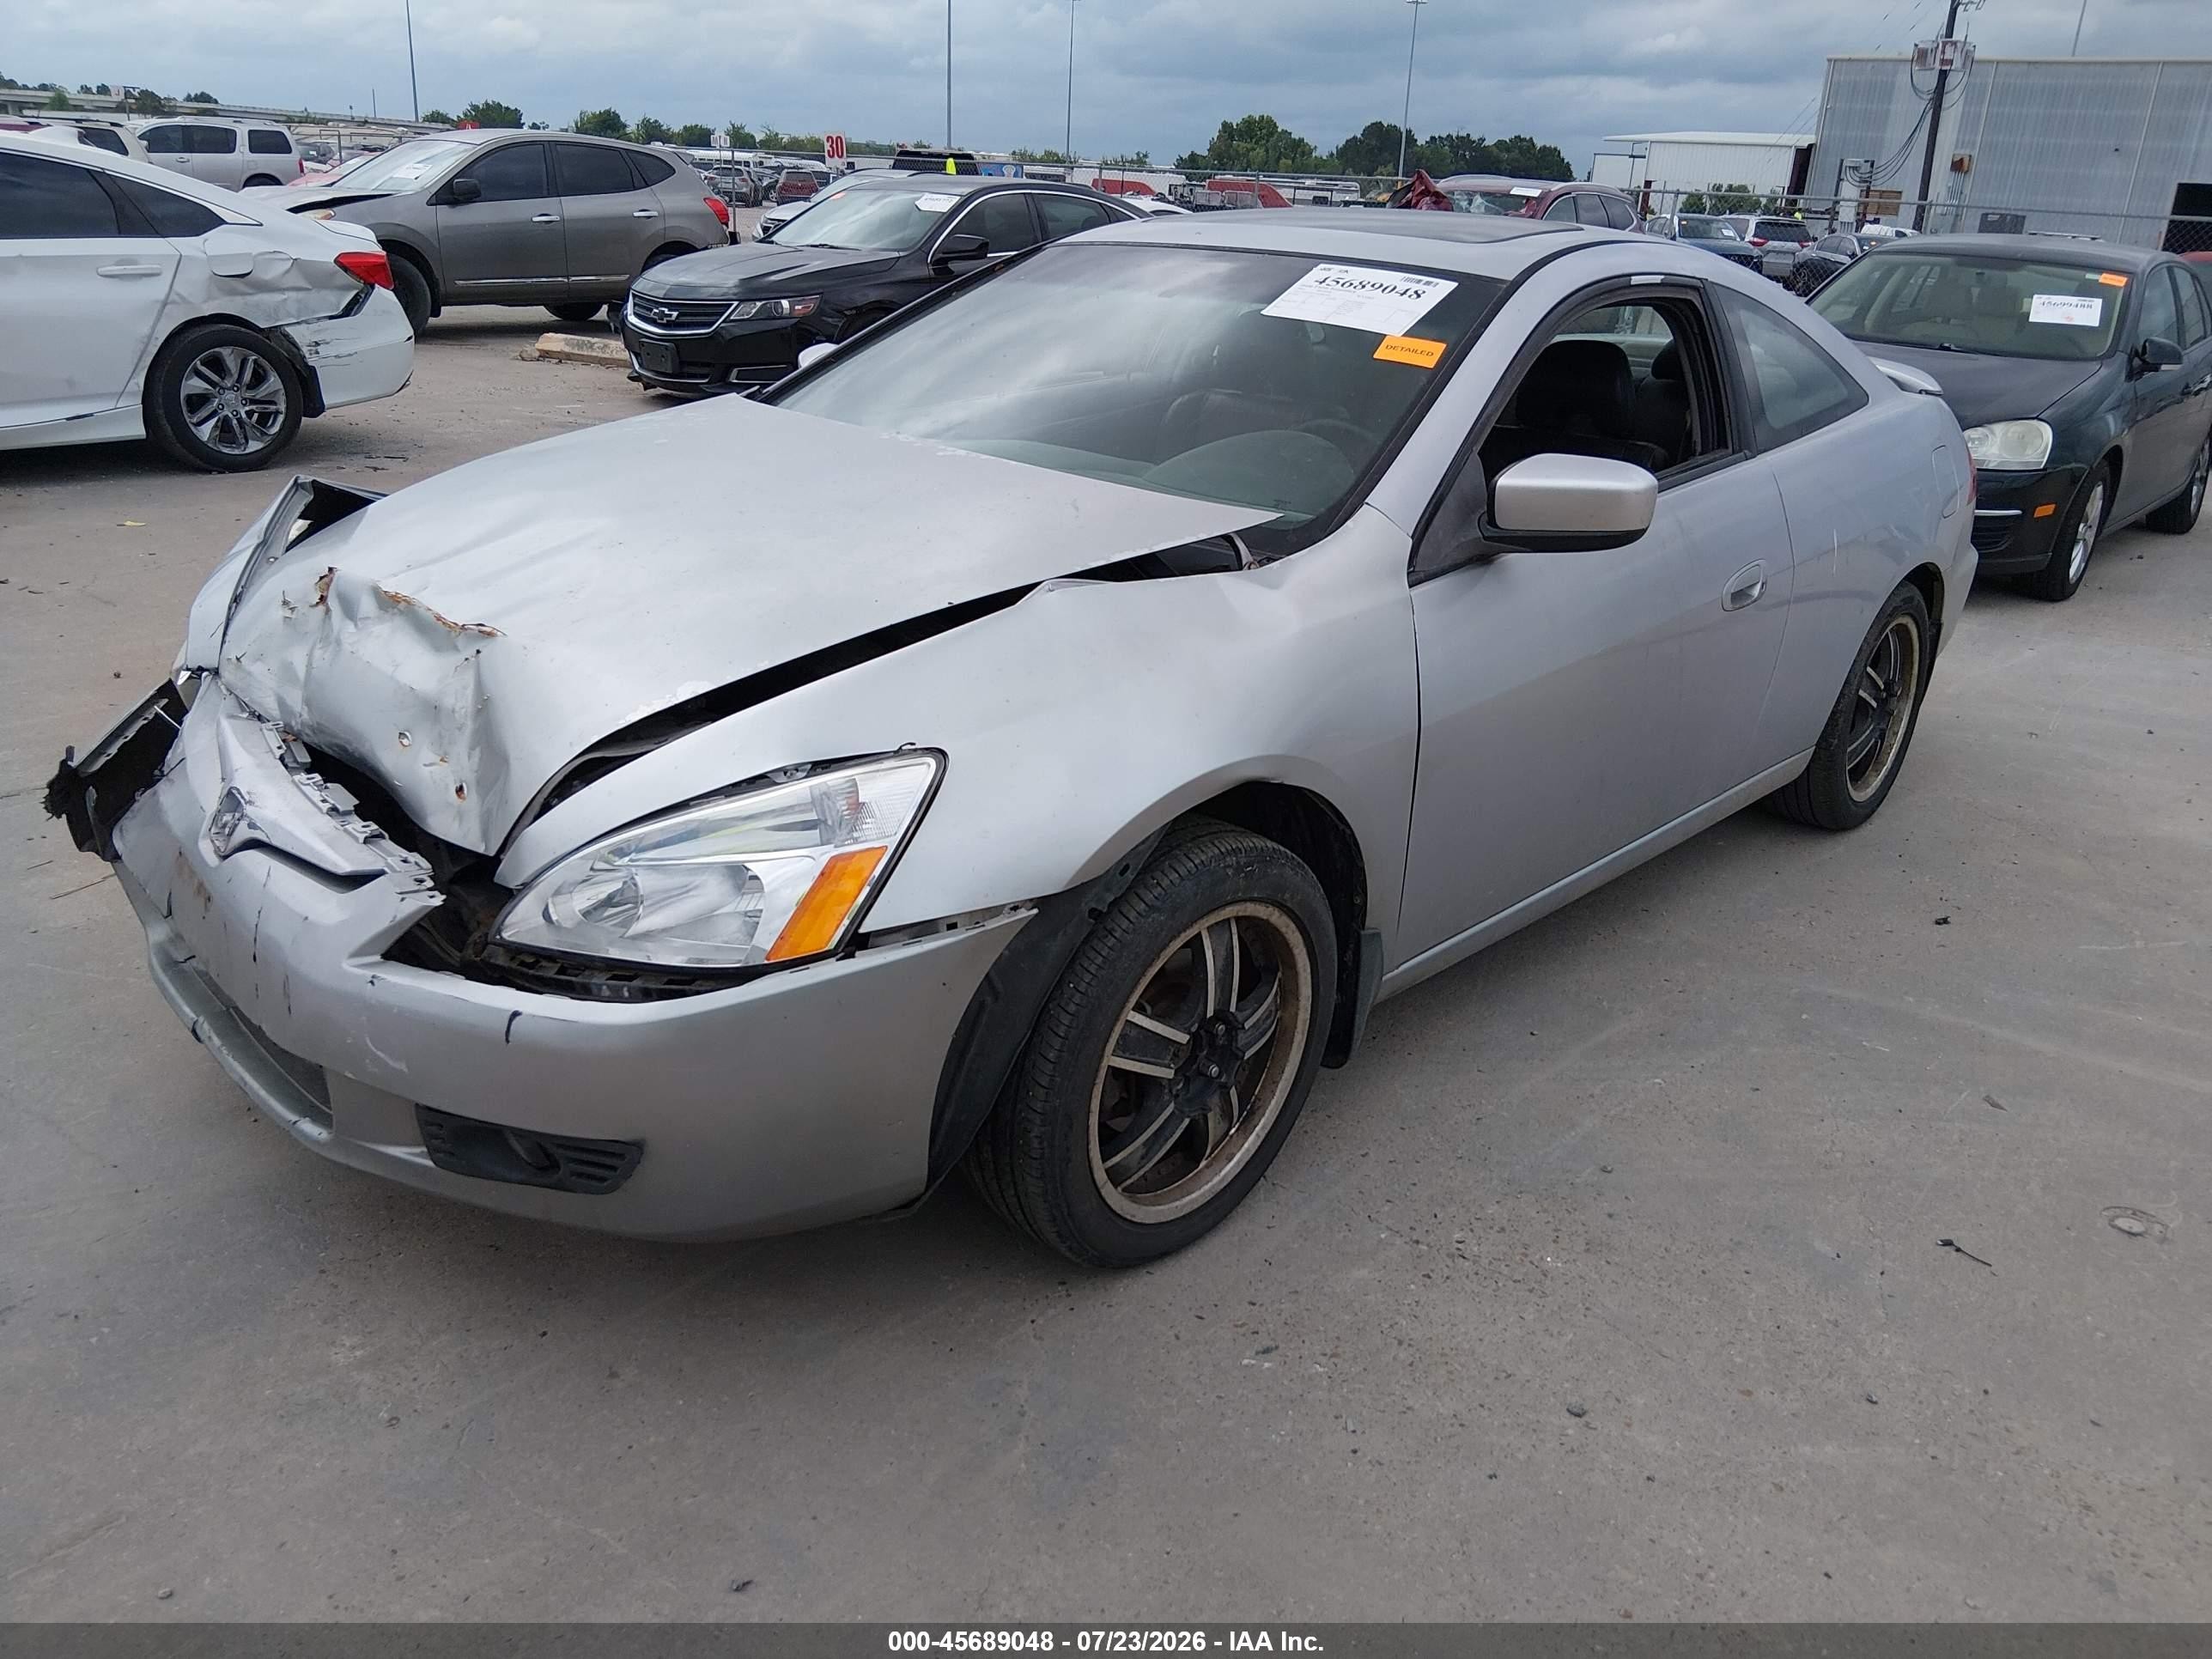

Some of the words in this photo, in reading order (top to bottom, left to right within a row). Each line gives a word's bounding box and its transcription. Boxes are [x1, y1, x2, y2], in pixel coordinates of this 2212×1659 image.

[826, 136, 844, 159] 30
[1314, 275, 1427, 301] 45689048
[1385, 343, 1435, 357] DETAILED
